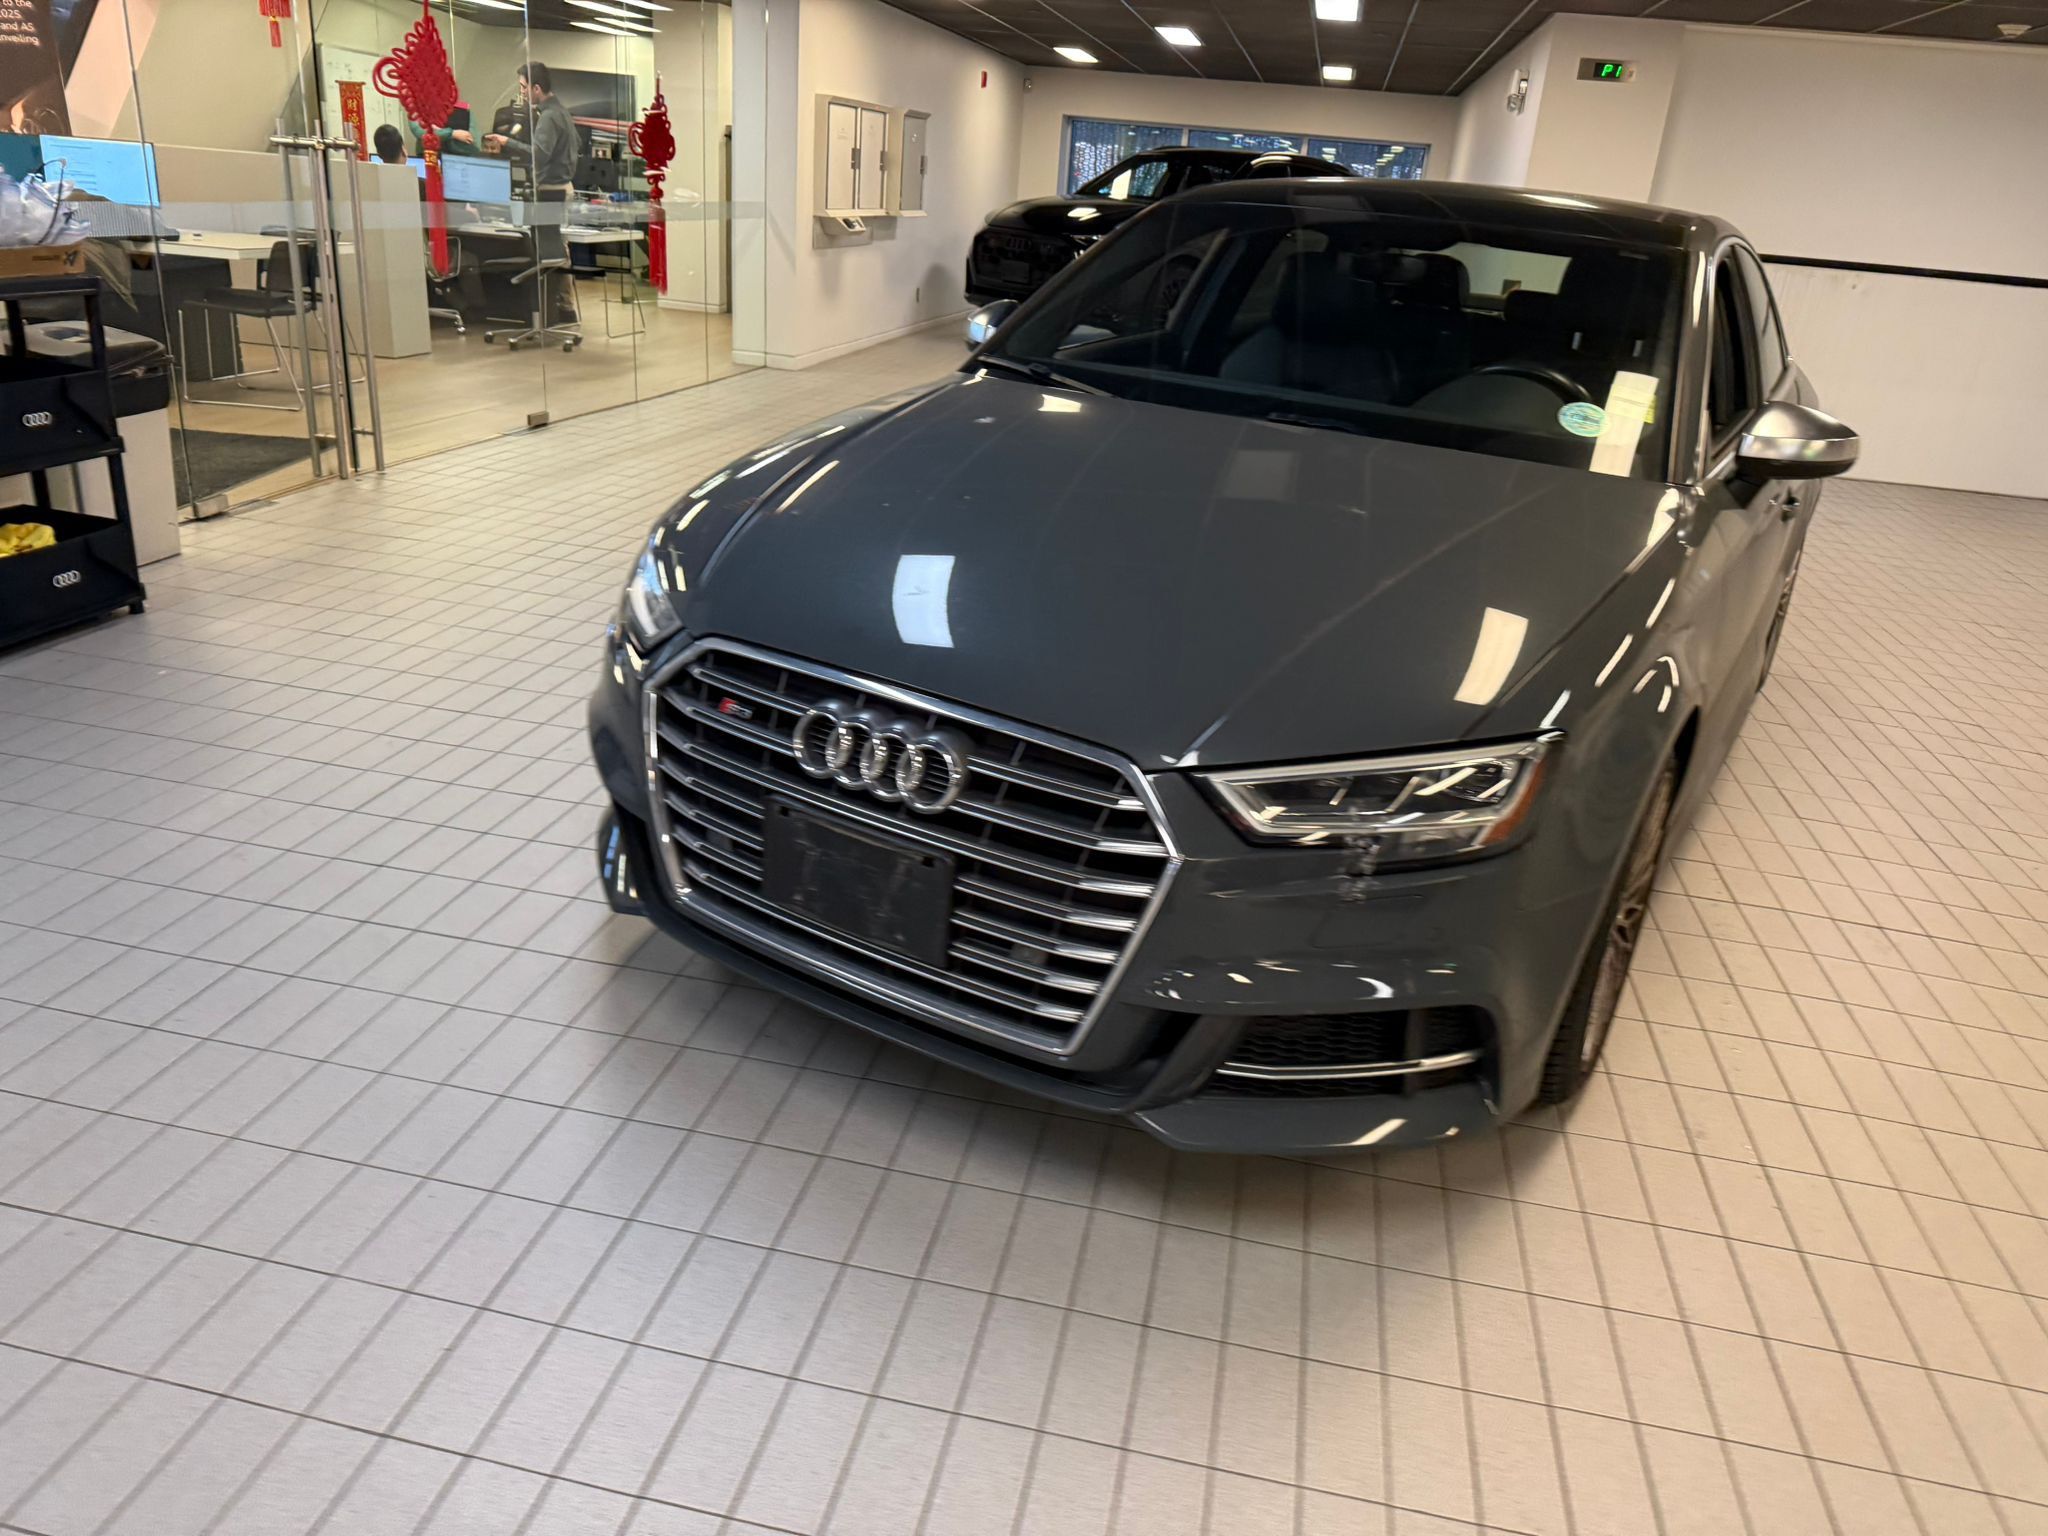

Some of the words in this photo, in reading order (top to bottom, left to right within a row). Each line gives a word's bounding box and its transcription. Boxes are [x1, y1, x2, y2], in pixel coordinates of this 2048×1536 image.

[0, 9, 22, 19] 025
[0, 34, 40, 46] nveiling
[1602, 64, 1622, 78] P1
